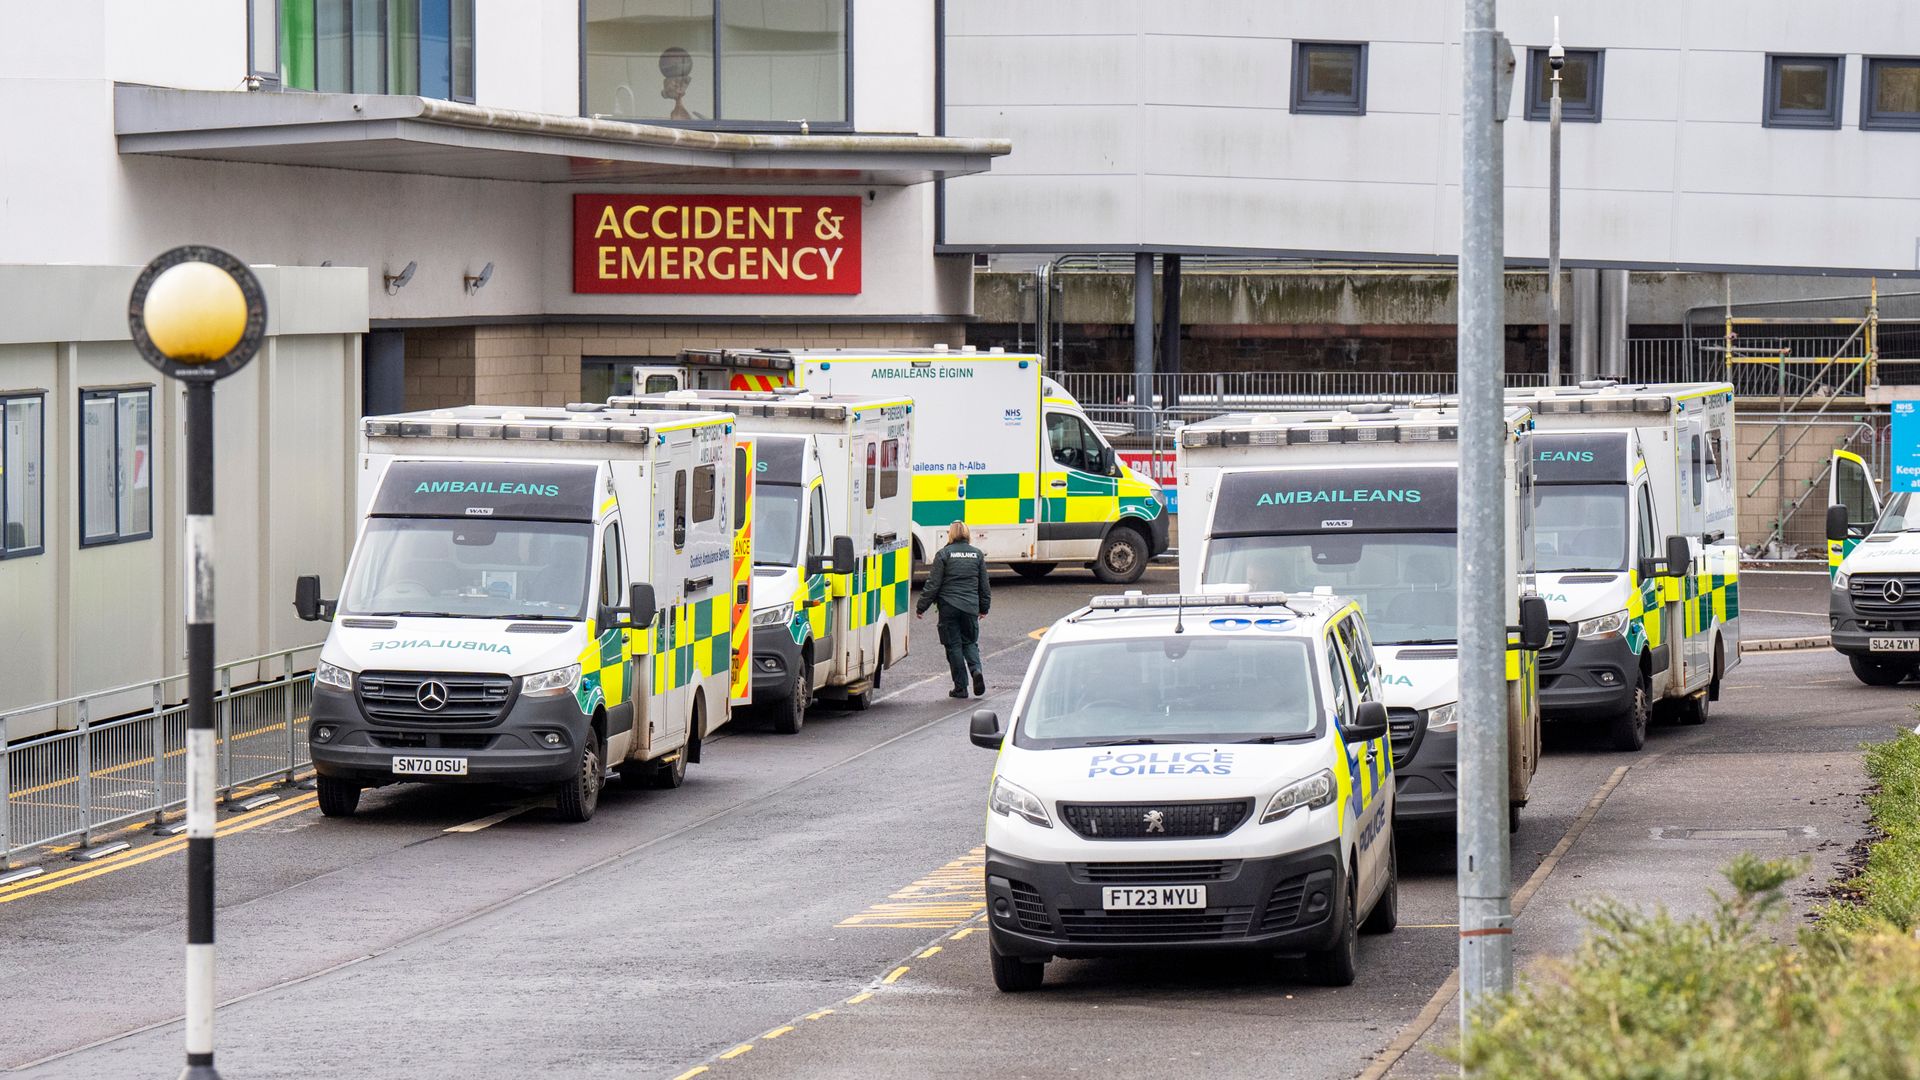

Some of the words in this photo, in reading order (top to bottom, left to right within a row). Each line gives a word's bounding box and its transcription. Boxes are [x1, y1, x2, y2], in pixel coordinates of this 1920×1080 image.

[594, 205, 803, 239] ACCIDENT
[814, 207, 845, 241] &
[598, 246, 843, 281] EMERGENCY
[871, 368, 936, 378] AMBAILEANS
[1005, 408, 1021, 416] NHS
[912, 462, 944, 472] aileans
[947, 463, 957, 471] na
[960, 461, 986, 471] h-Alba
[414, 481, 560, 497] AMBAILEANS
[1256, 489, 1422, 506] AMBAILEANS
[1873, 640, 1895, 649] SL24
[1897, 640, 1914, 649] ZWY
[399, 759, 431, 772] SN70
[435, 760, 461, 772] OSU
[1090, 752, 1234, 766] POLICE
[1088, 765, 1232, 778] POILEAS
[1360, 800, 1385, 851] POLICE
[1111, 889, 1157, 906] FT23
[1163, 888, 1198, 905] MYU
